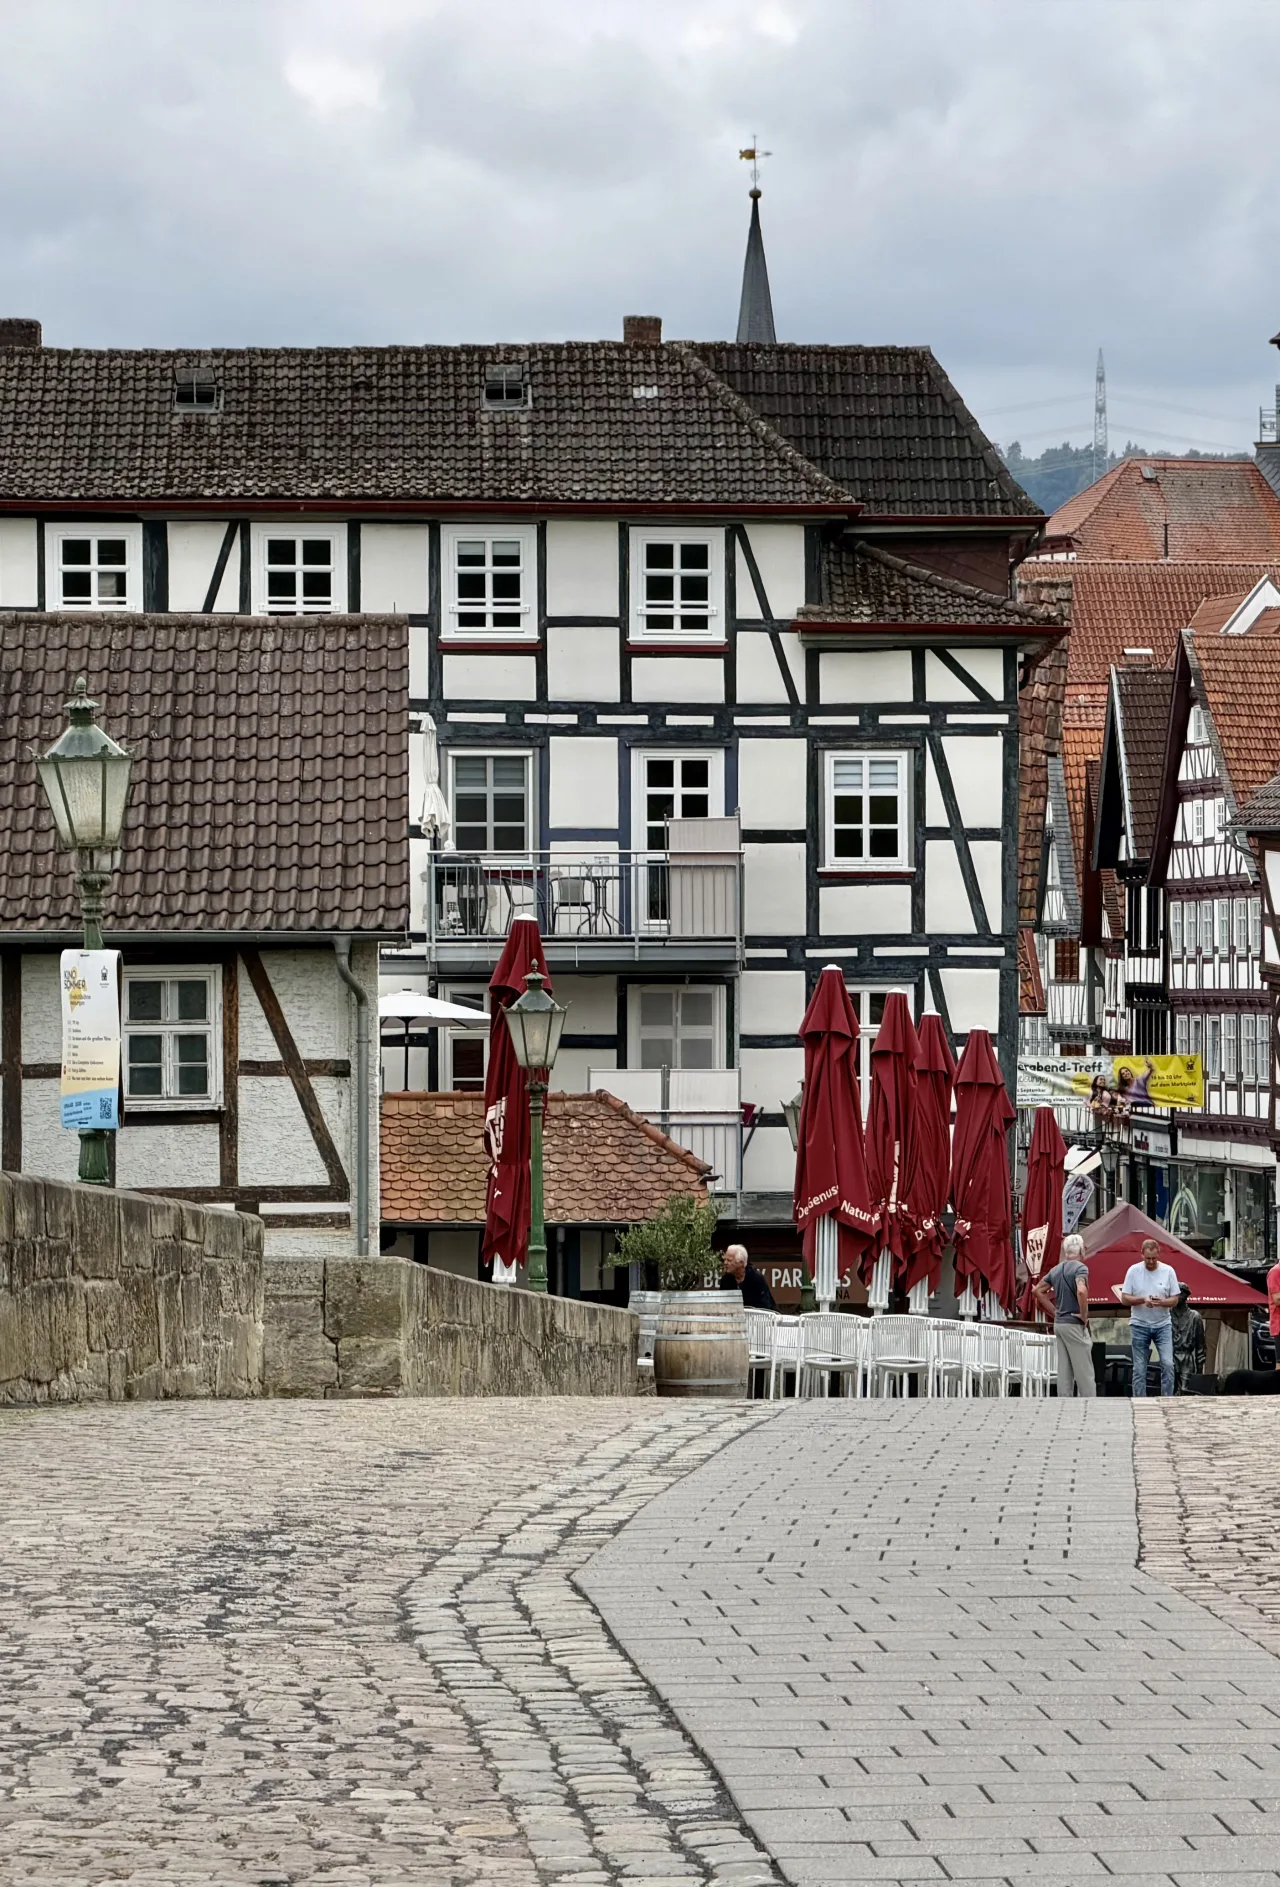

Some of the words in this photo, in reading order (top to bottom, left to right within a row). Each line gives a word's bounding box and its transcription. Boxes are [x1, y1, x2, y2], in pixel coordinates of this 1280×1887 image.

[64, 970, 76, 979] KINO
[64, 980, 86, 989] SOMMER
[1018, 1062, 1103, 1072] erabend-Treff
[808, 1185, 839, 1209] Genus
[840, 1200, 871, 1222] Natur
